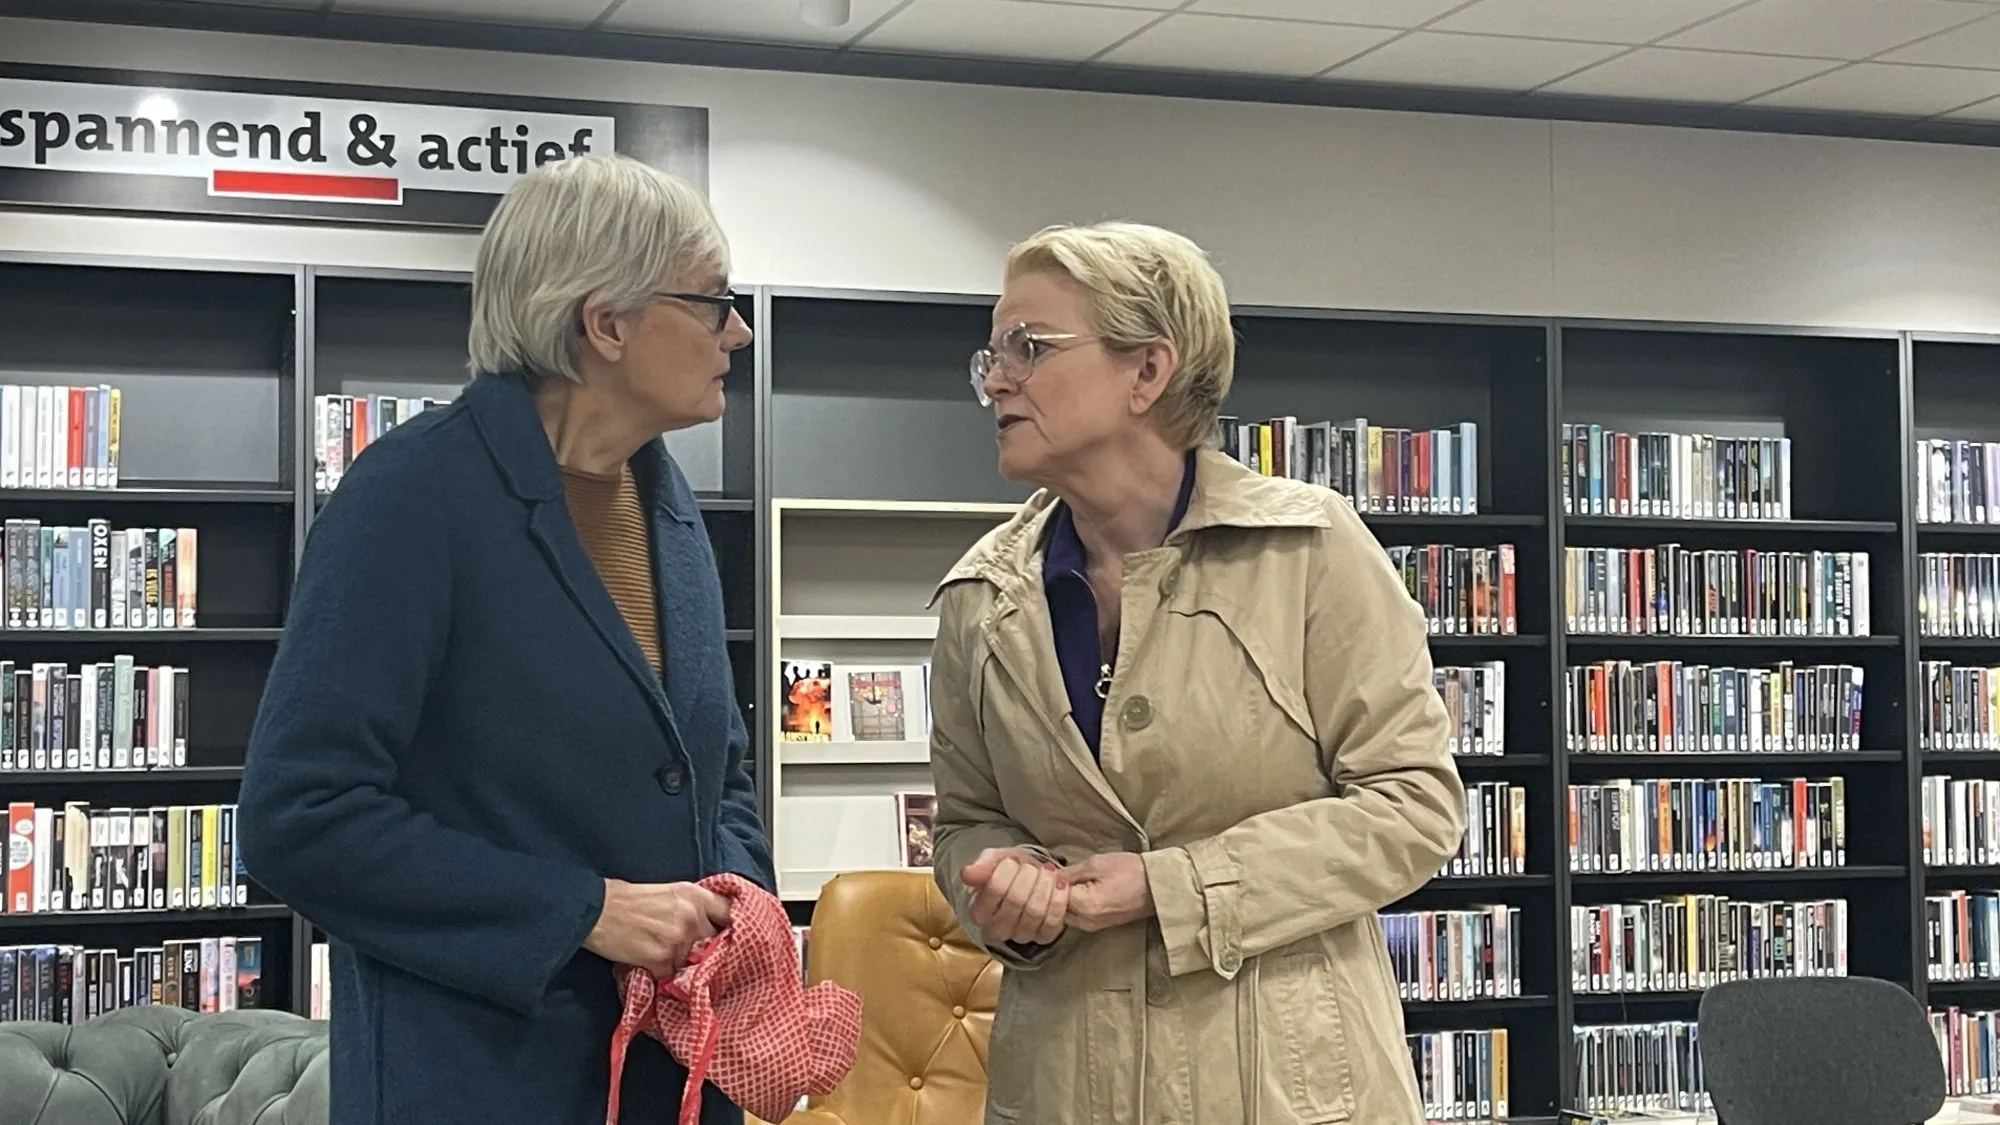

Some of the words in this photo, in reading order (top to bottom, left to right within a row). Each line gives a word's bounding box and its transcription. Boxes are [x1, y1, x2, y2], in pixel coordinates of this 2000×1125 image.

[0, 109, 328, 165] spannend
[346, 113, 398, 169] &
[93, 524, 108, 569] OXEN
